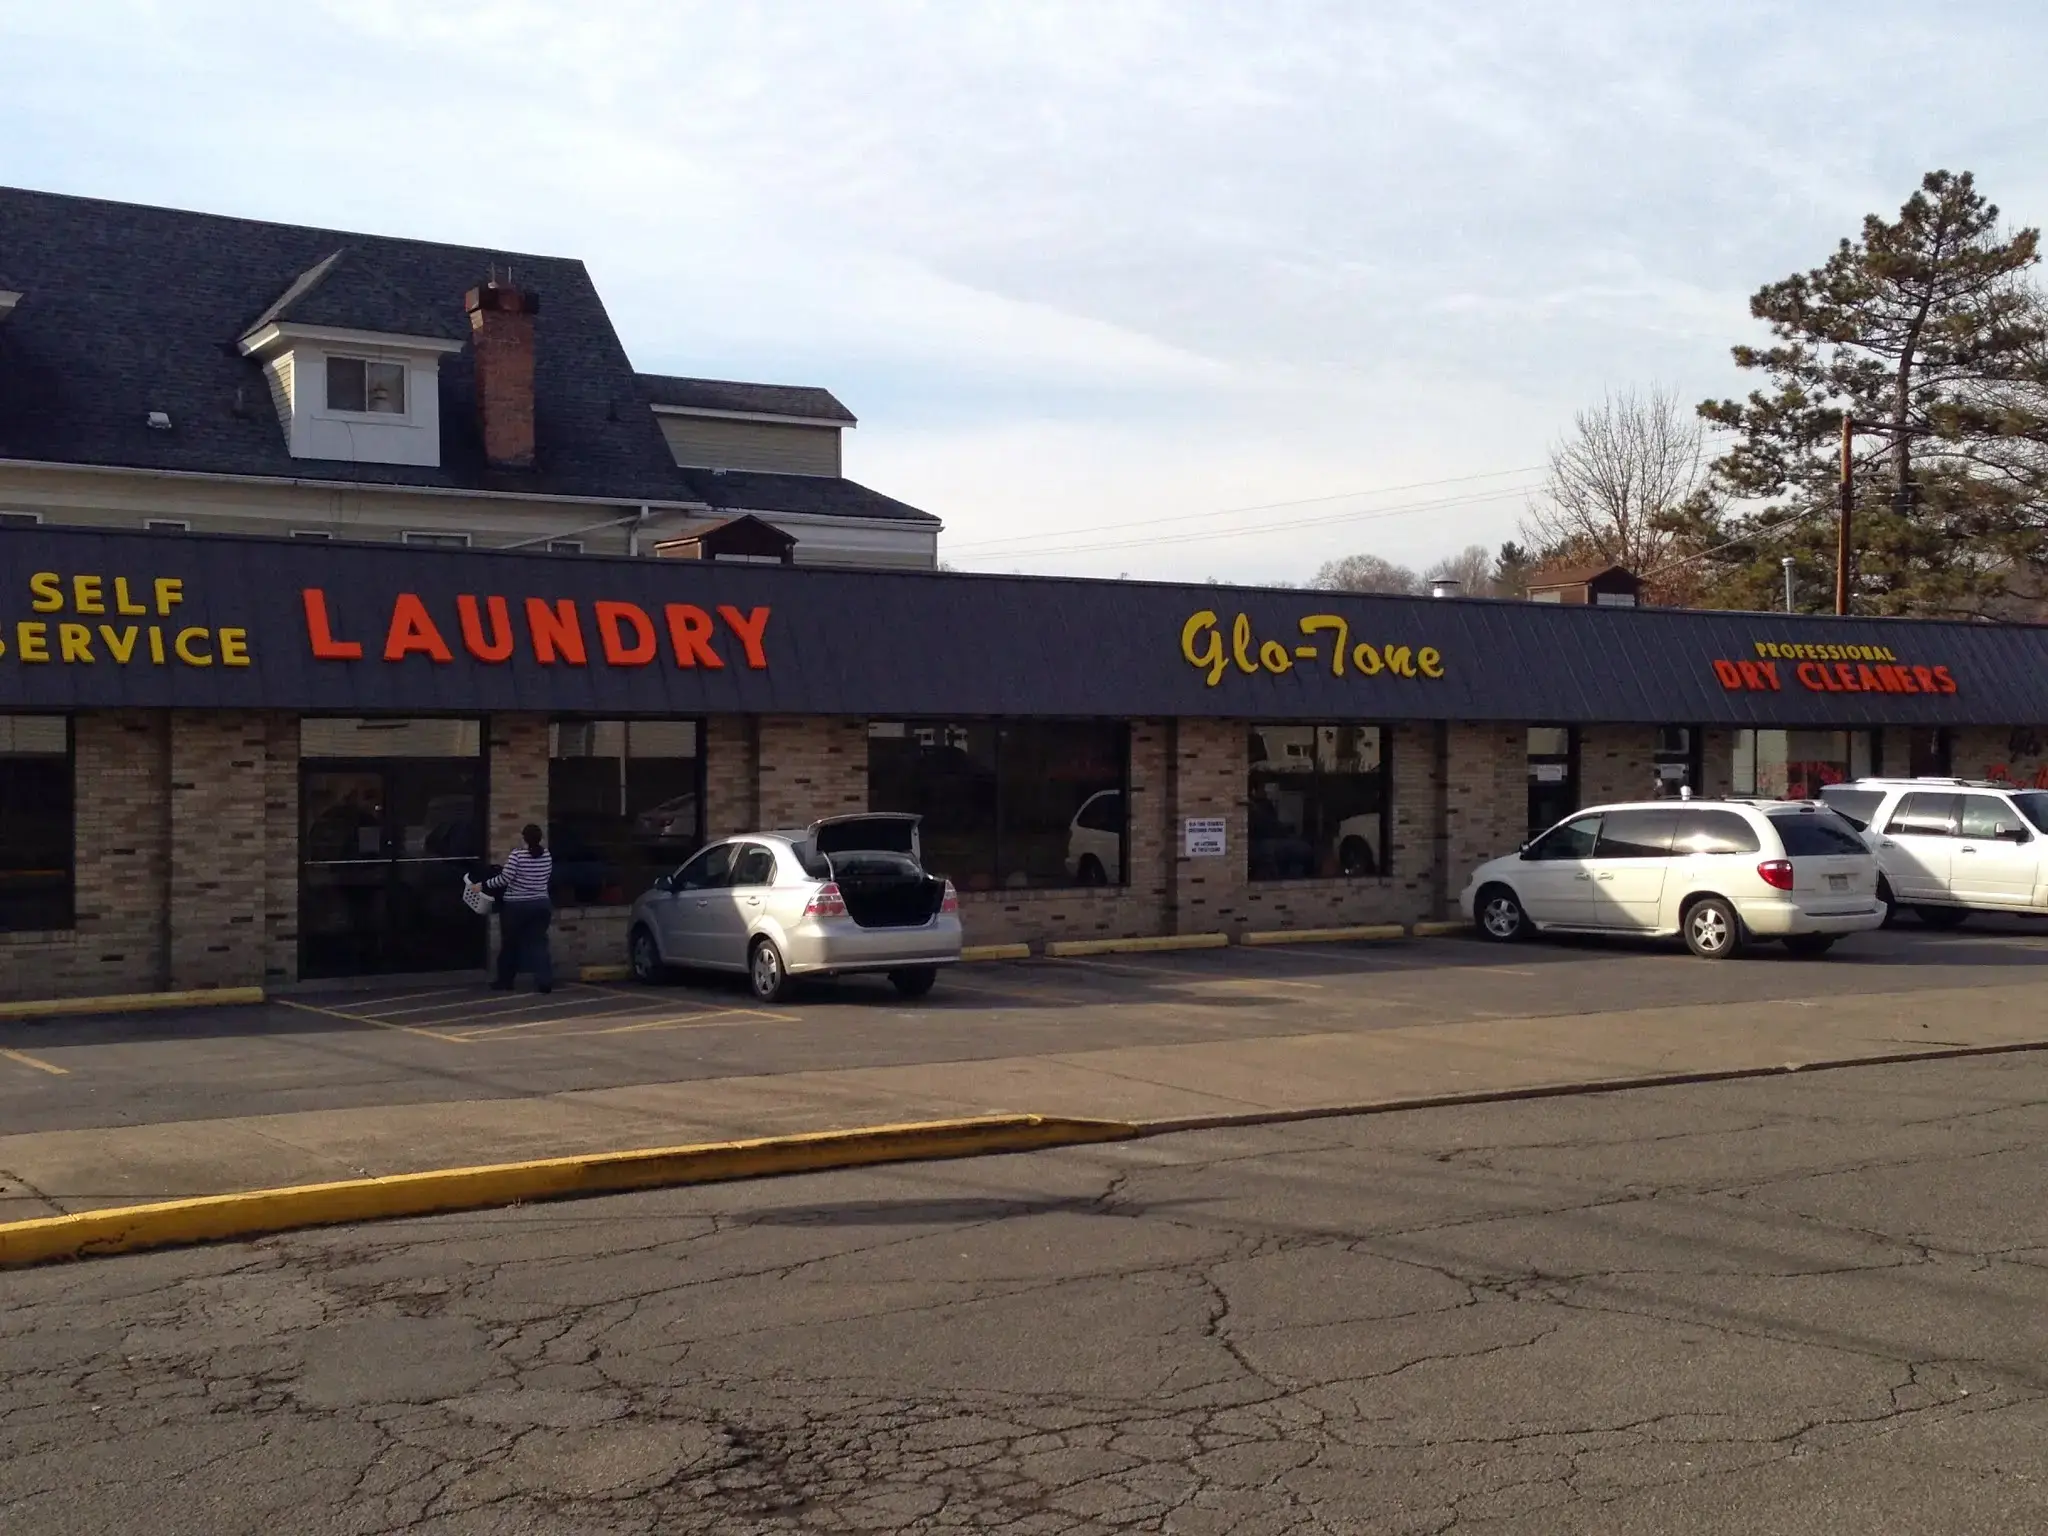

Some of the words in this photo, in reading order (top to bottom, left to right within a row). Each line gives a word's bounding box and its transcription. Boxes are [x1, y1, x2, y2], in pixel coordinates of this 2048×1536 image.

[30, 572, 184, 616] SELF
[0, 620, 251, 667] ERVICE
[303, 588, 771, 669] LAUNDRY
[1181, 610, 1445, 687] Glo-Tone
[1754, 642, 1897, 662] PROFESSIONAL
[1713, 659, 1782, 692] DRY
[1796, 662, 1957, 694] CLEANERS
